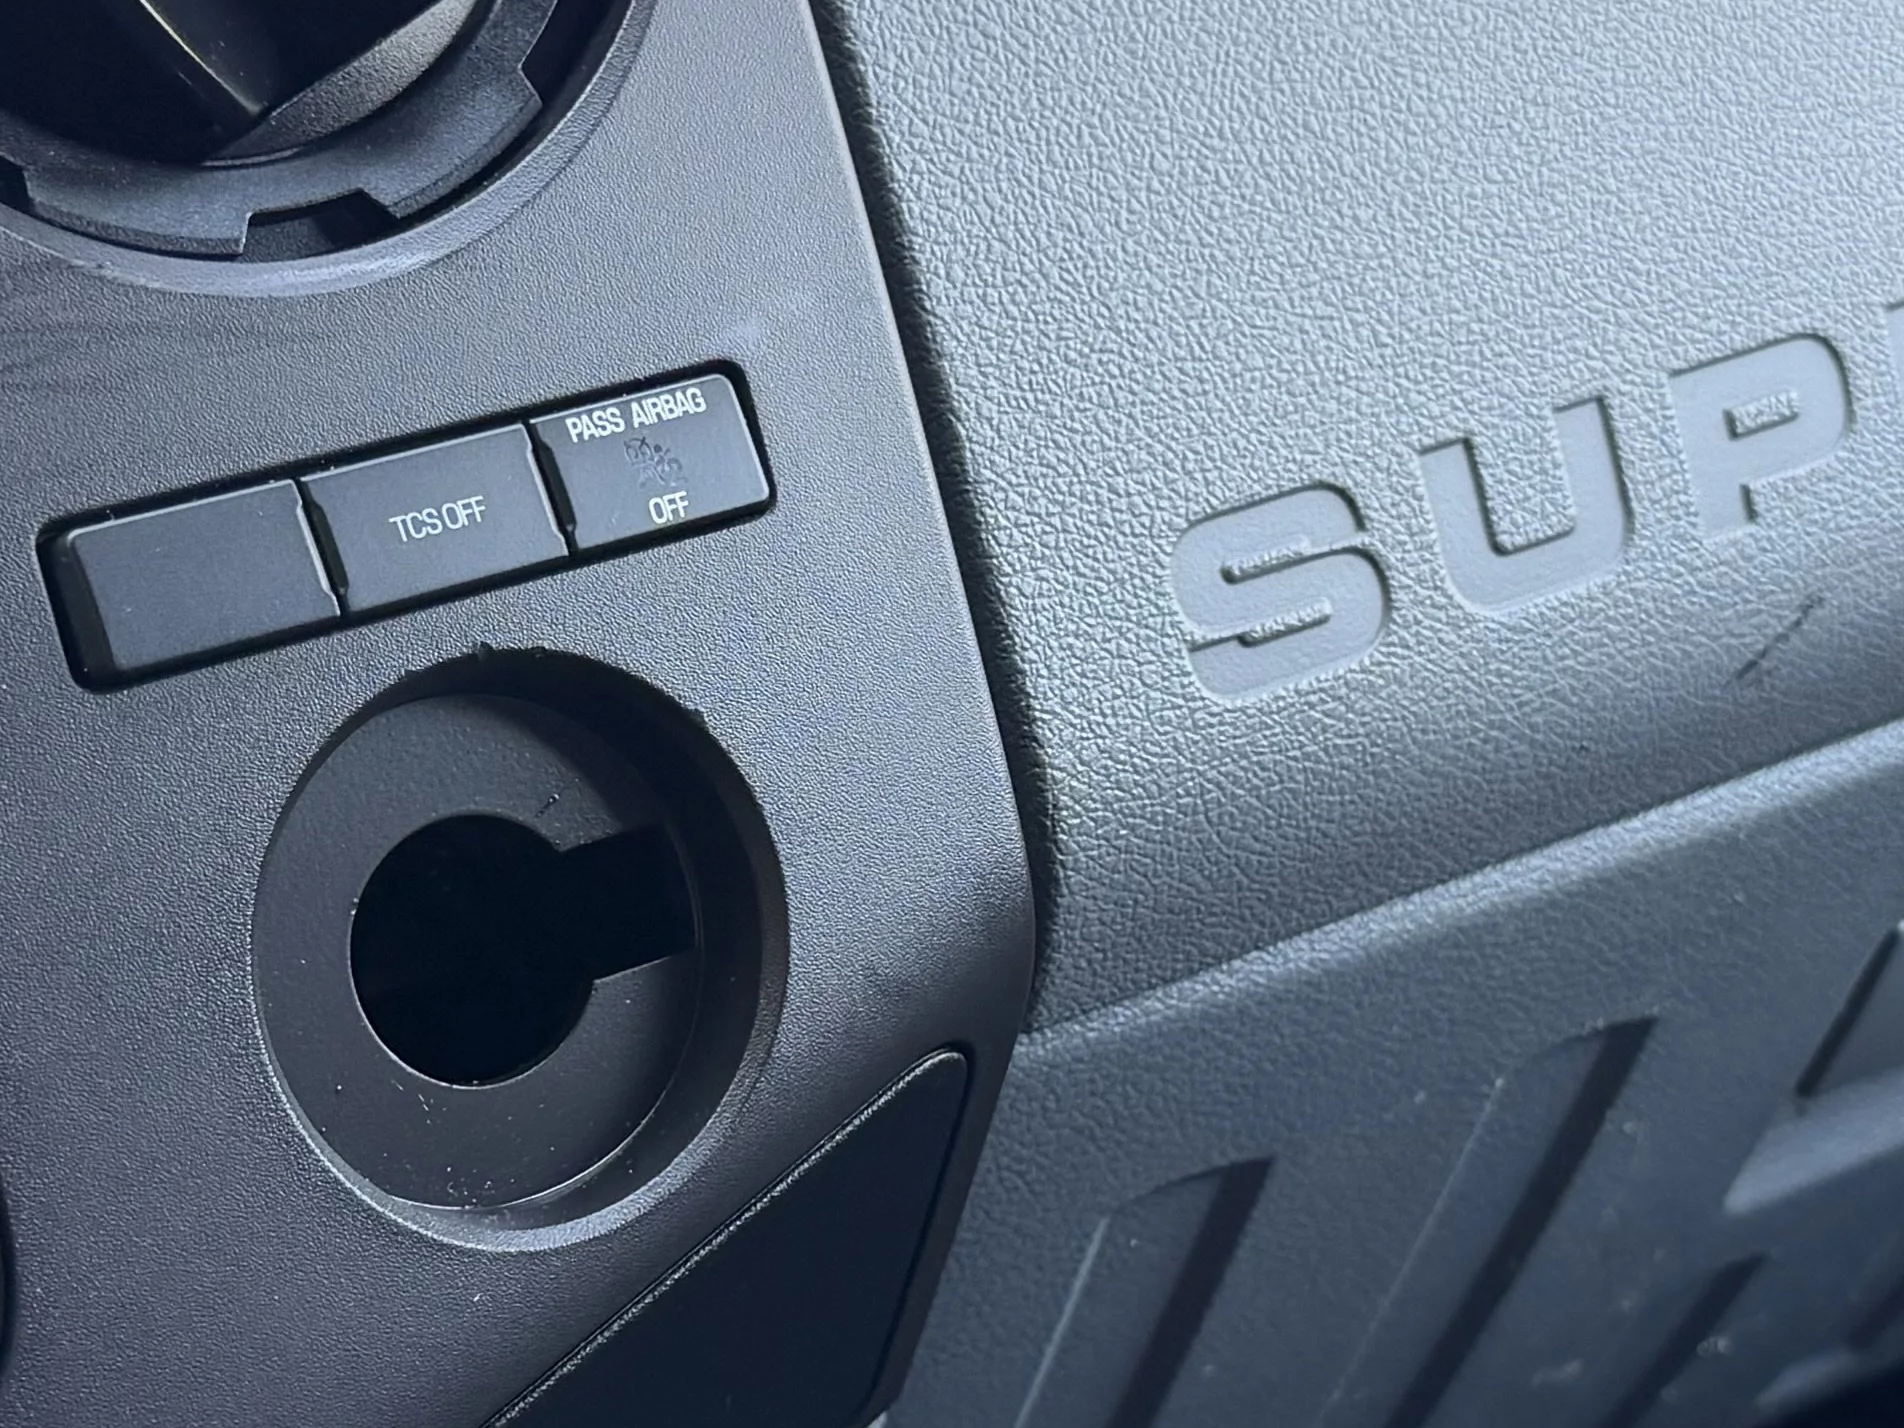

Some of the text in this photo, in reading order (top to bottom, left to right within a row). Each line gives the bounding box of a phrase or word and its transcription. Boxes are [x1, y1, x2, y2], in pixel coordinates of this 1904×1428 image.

[565, 387, 707, 444] PASS AIRBAG
[648, 490, 690, 525] OFF
